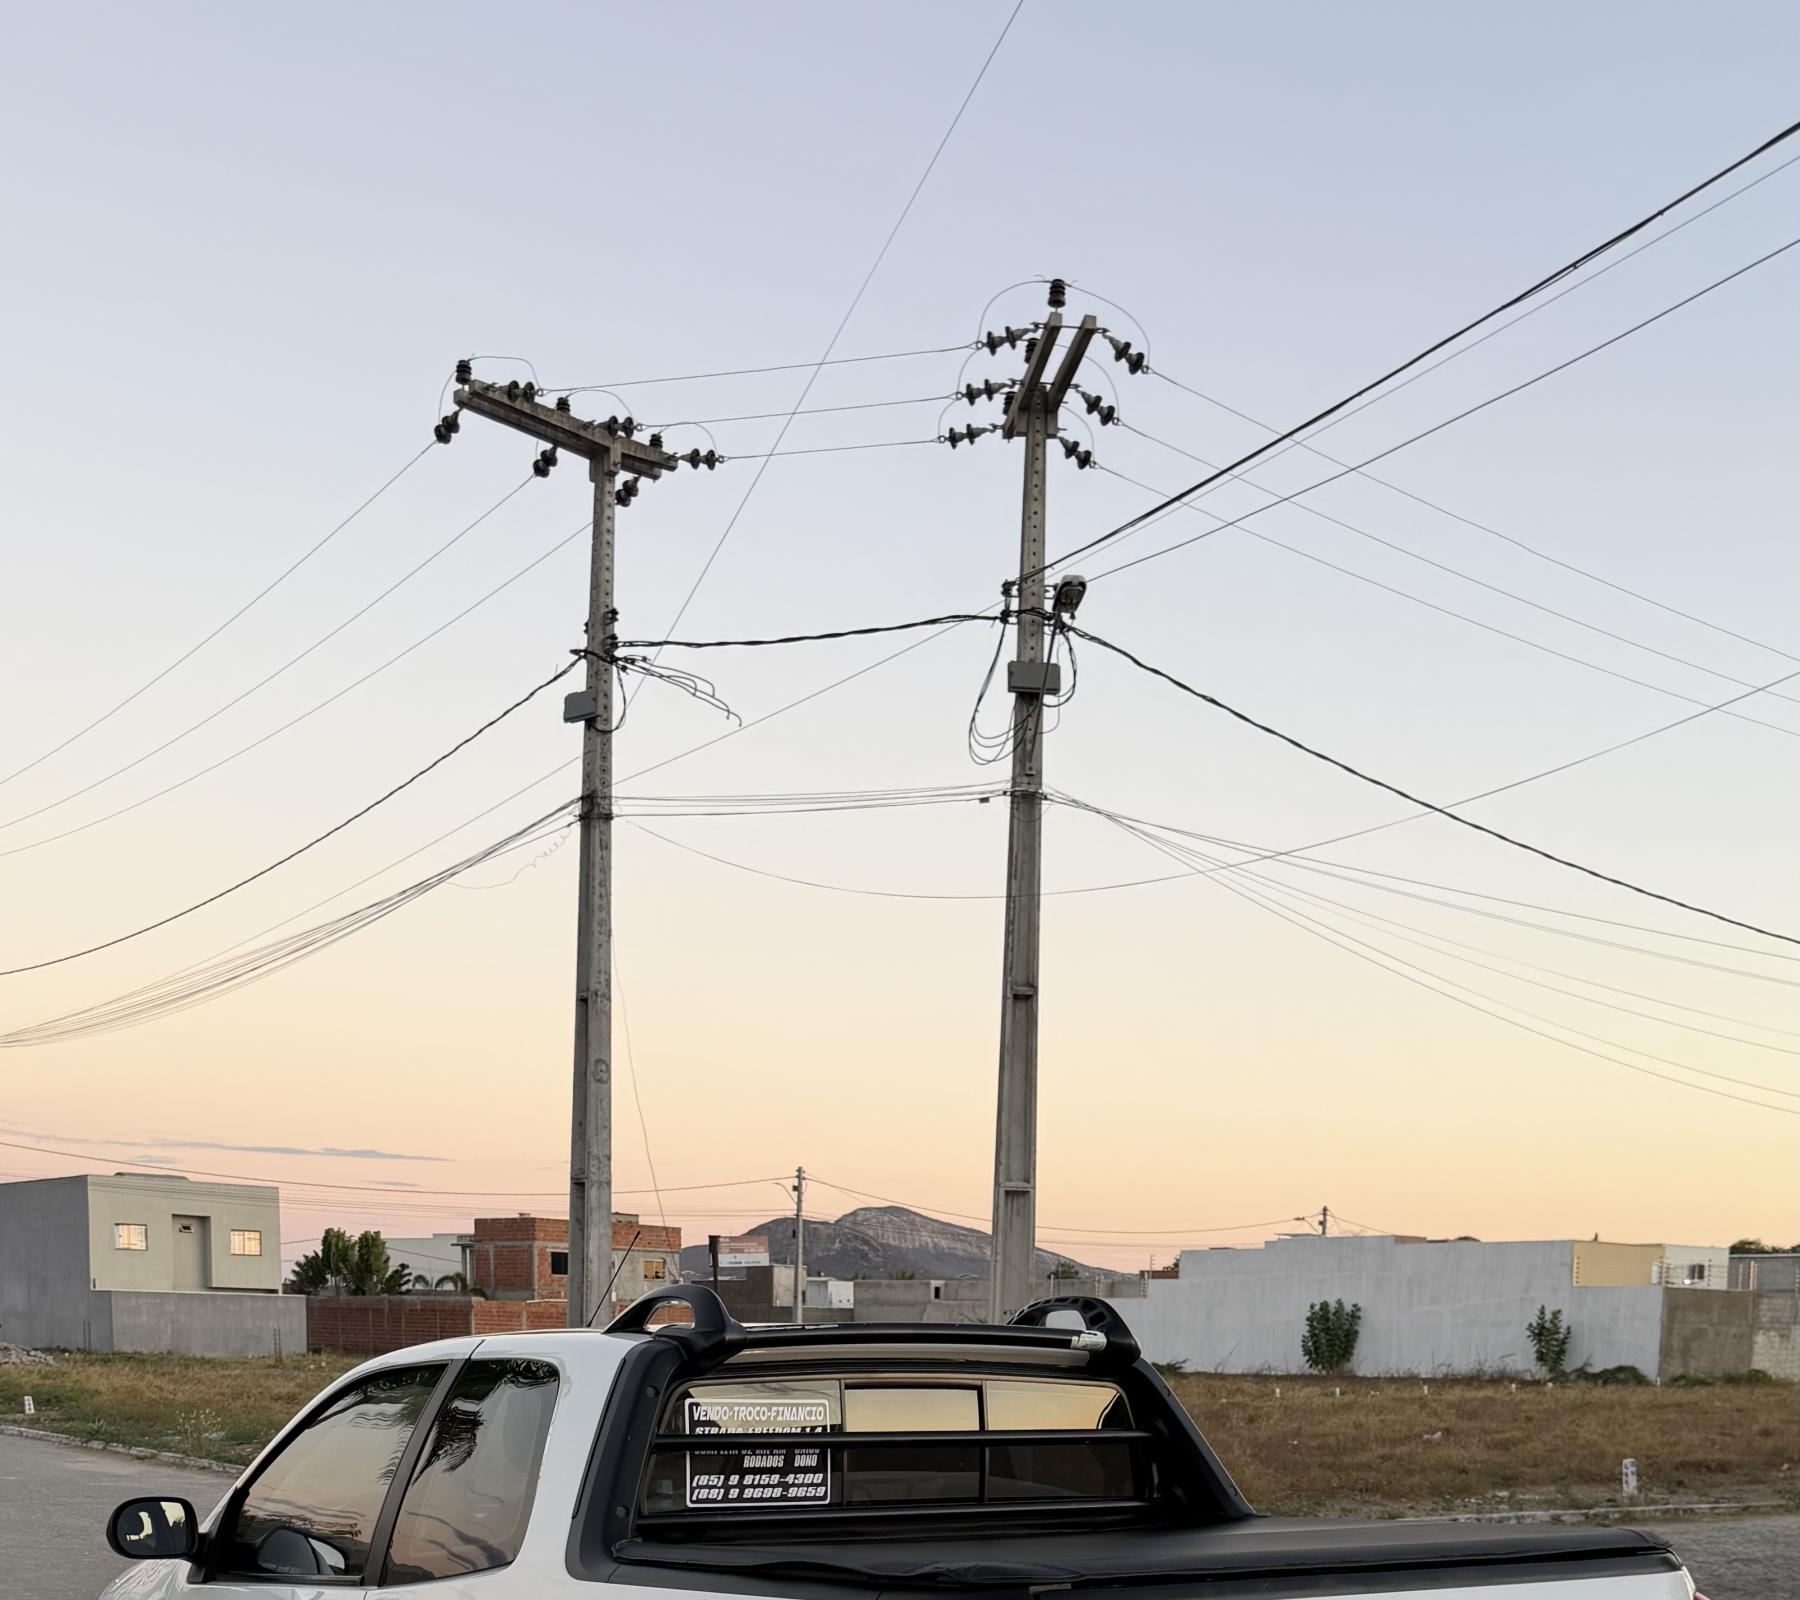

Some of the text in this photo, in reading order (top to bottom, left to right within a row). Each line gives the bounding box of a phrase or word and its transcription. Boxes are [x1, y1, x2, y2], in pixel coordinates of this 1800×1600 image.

[743, 1455, 785, 1468] RODADOS
[794, 1454, 818, 1467] DONO
[692, 1475, 725, 1487] (85)
[728, 1475, 740, 1485] 9
[692, 1488, 725, 1501] (88)
[728, 1488, 740, 1499] 9
